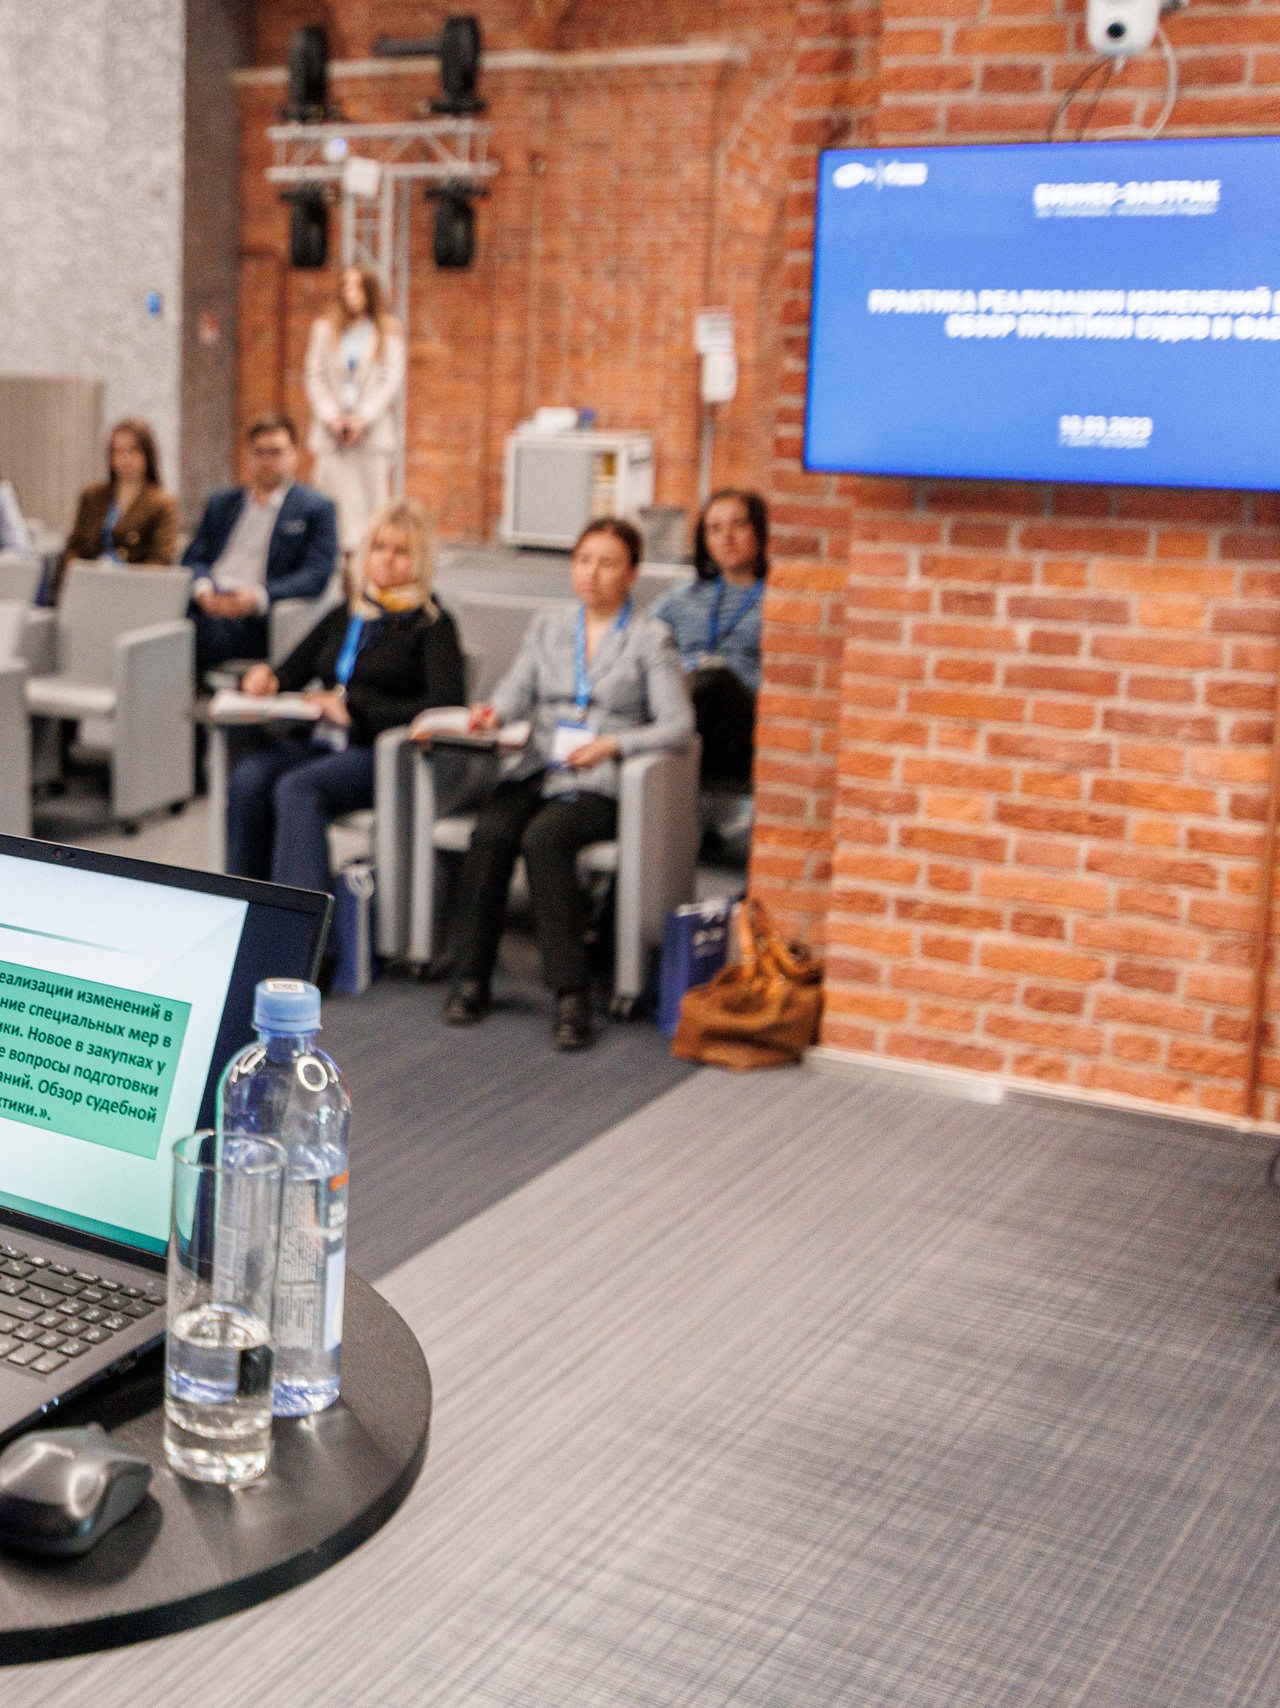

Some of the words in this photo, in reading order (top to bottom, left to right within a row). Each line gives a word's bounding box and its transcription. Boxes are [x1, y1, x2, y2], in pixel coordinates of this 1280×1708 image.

[869, 289, 976, 314] ПРАКТИКА
[978, 289, 1125, 316] РЕАЛИЗАЦИИ
[1127, 286, 1270, 315] ИЗМЕНЕНИЙ
[1018, 314, 1133, 339] ПРАКТИКИ
[1134, 315, 1210, 342] СУДОВ
[1211, 315, 1231, 340] И
[29, 1003, 125, 1038] специальных
[128, 1028, 158, 1048] мер
[162, 1036, 172, 1048] в
[76, 990, 160, 1022] изменений
[164, 1009, 172, 1022] в
[8, 1048, 70, 1075] вопросы
[74, 1064, 159, 1097] подготовки
[27, 1026, 72, 1049] Новое
[75, 1041, 84, 1052] в
[86, 1043, 153, 1070] закупках
[157, 1061, 166, 1076] у
[38, 1080, 82, 1104] Обзор
[86, 1094, 157, 1124] судебной
